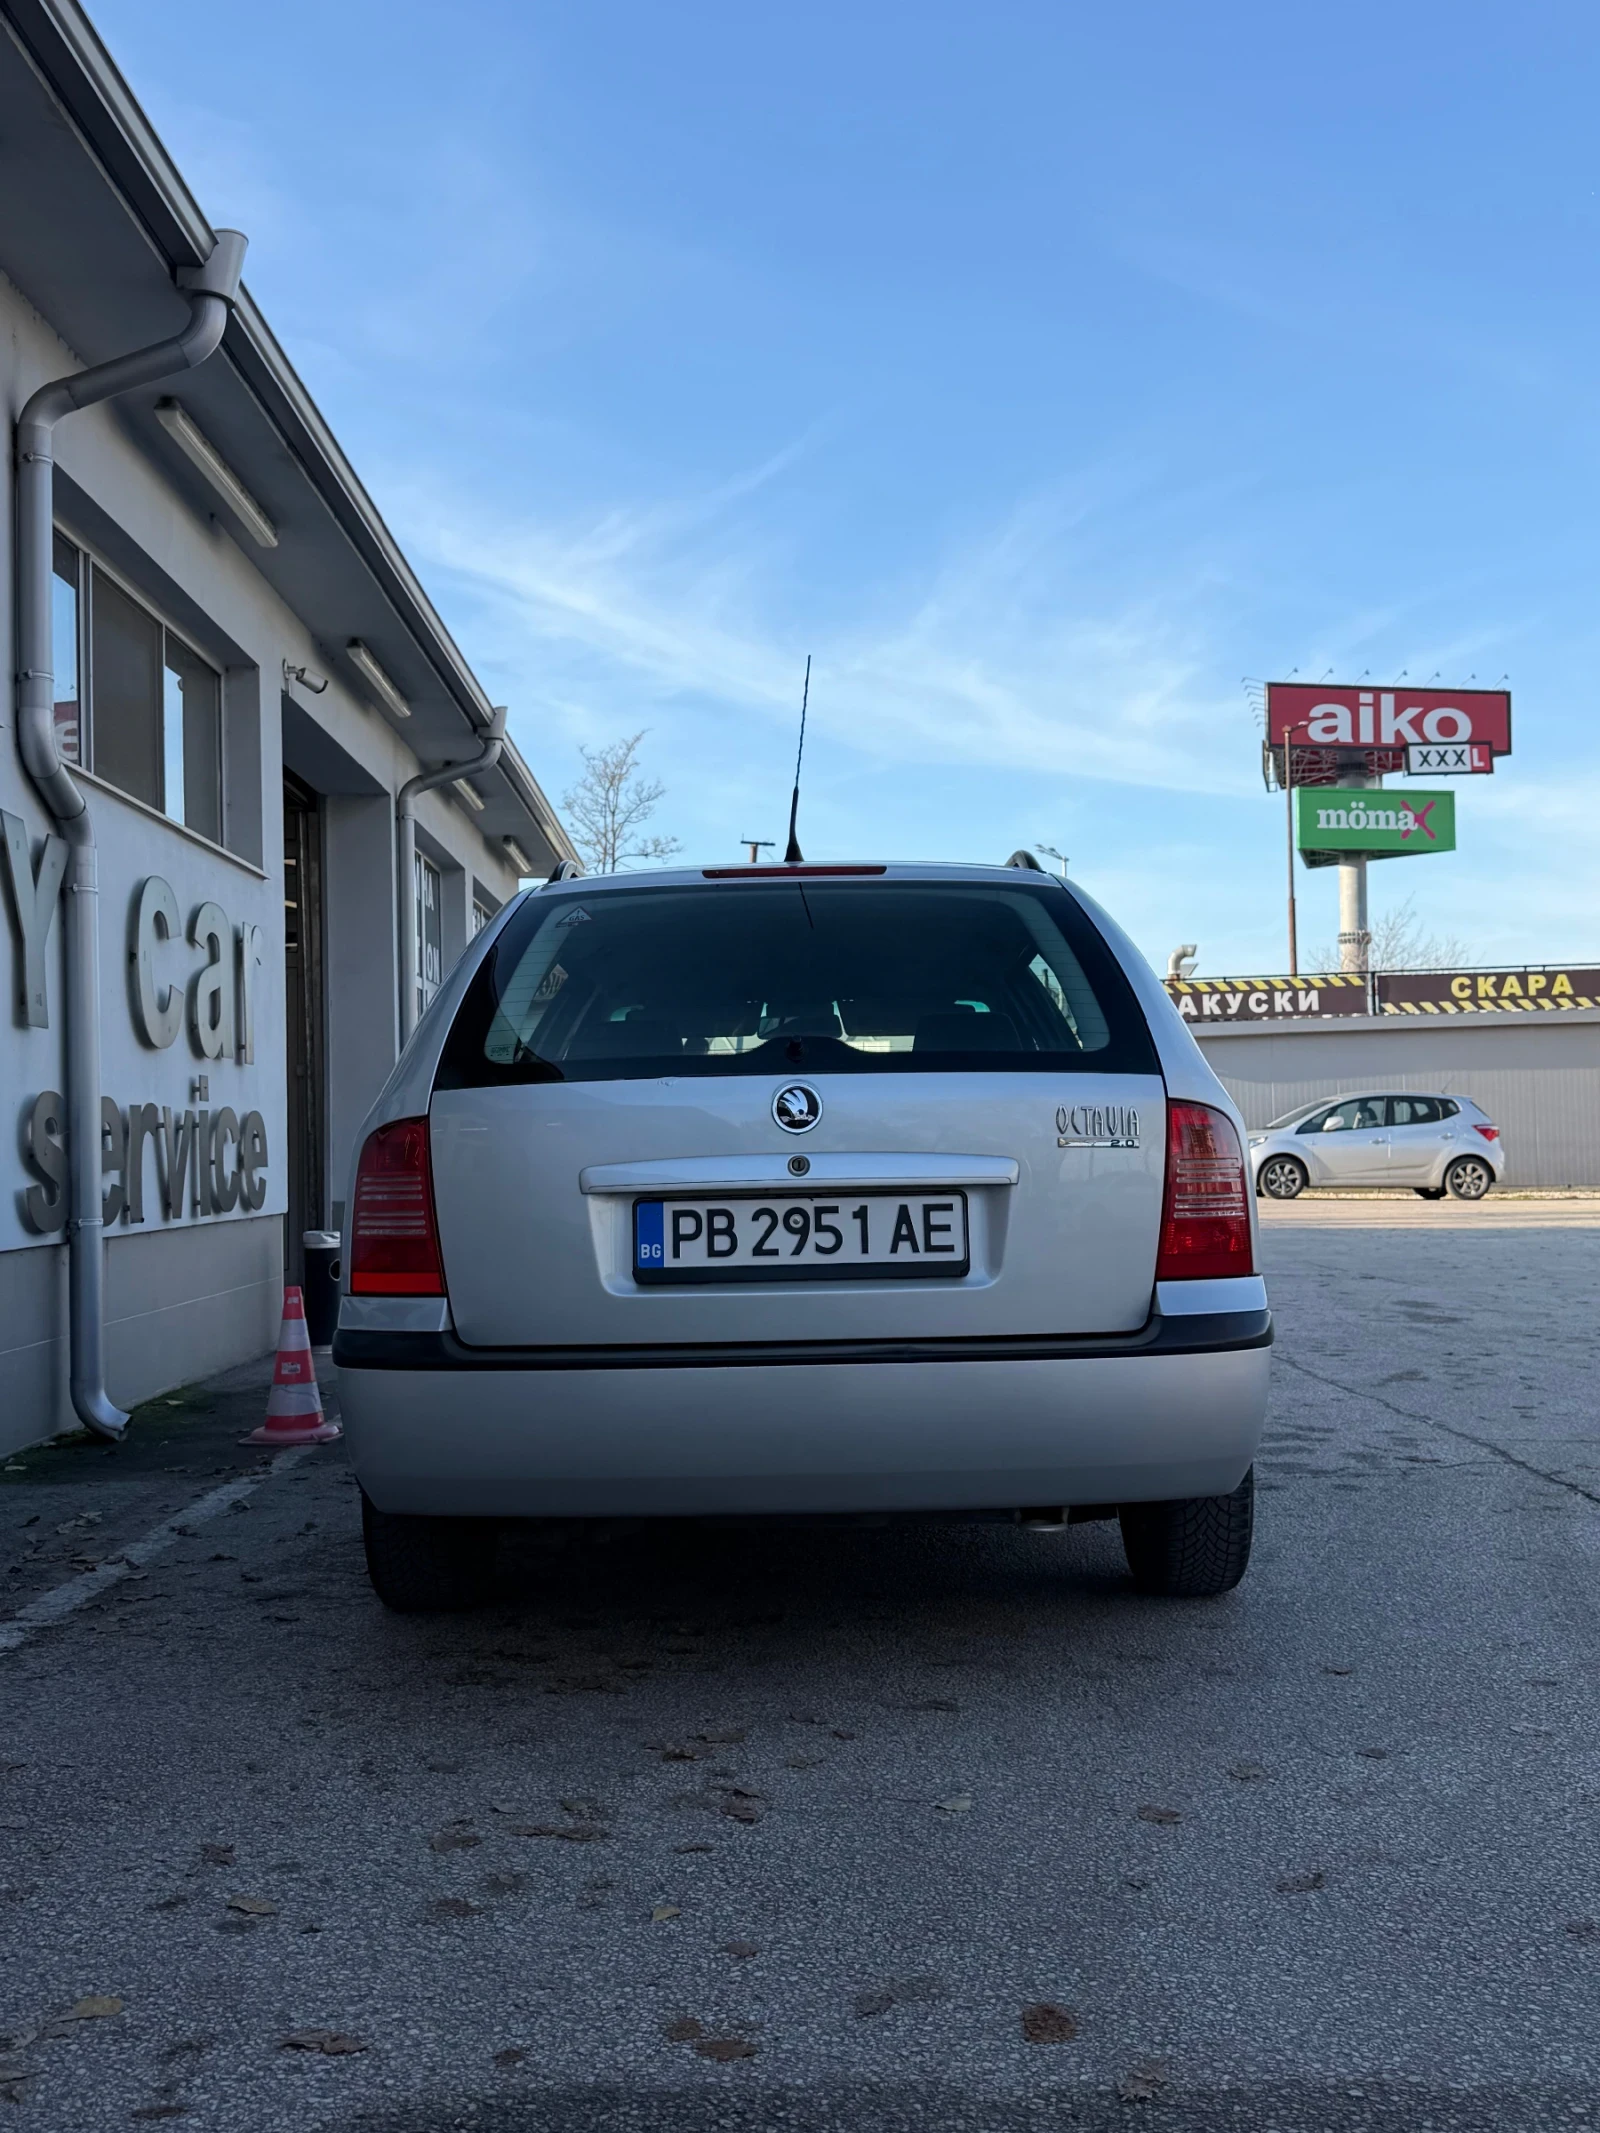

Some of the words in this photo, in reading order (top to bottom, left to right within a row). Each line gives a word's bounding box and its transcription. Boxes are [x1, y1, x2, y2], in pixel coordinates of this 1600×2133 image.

[1307, 692, 1473, 744] aiko
[1418, 748, 1485, 767] XXXL
[138, 875, 264, 1065] Car
[1451, 974, 1574, 998] СКАРА
[1056, 1104, 1140, 1137] OCTAVIA
[26, 1074, 269, 1233] service
[1110, 1139, 1136, 1148] 2.0
[671, 1208, 738, 1259] PB
[751, 1205, 870, 1258] 2951
[889, 1203, 956, 1255] AE
[640, 1243, 662, 1260] BG
